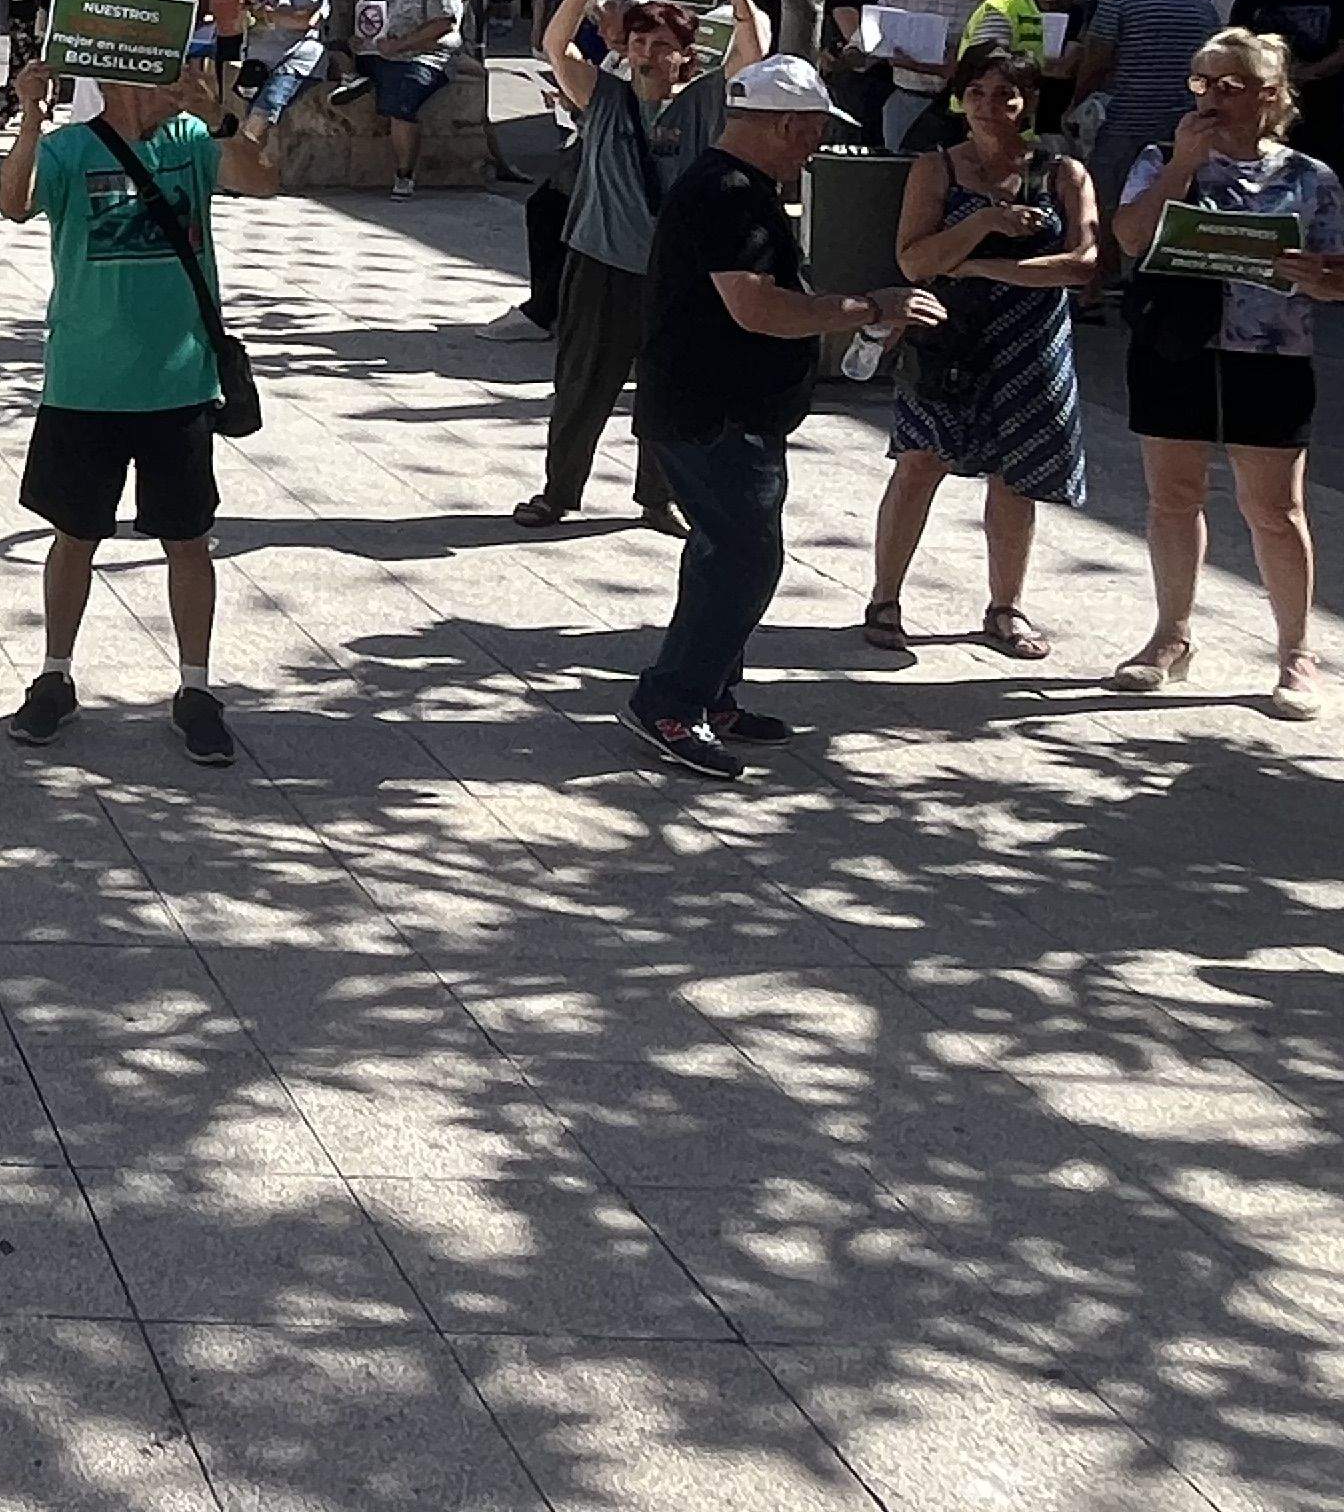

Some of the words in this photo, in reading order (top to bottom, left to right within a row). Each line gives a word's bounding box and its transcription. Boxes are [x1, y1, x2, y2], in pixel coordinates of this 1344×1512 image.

[82, 2, 160, 24] NUESTROS
[96, 40, 115, 50] en
[65, 50, 164, 74] BOLSILLOS
